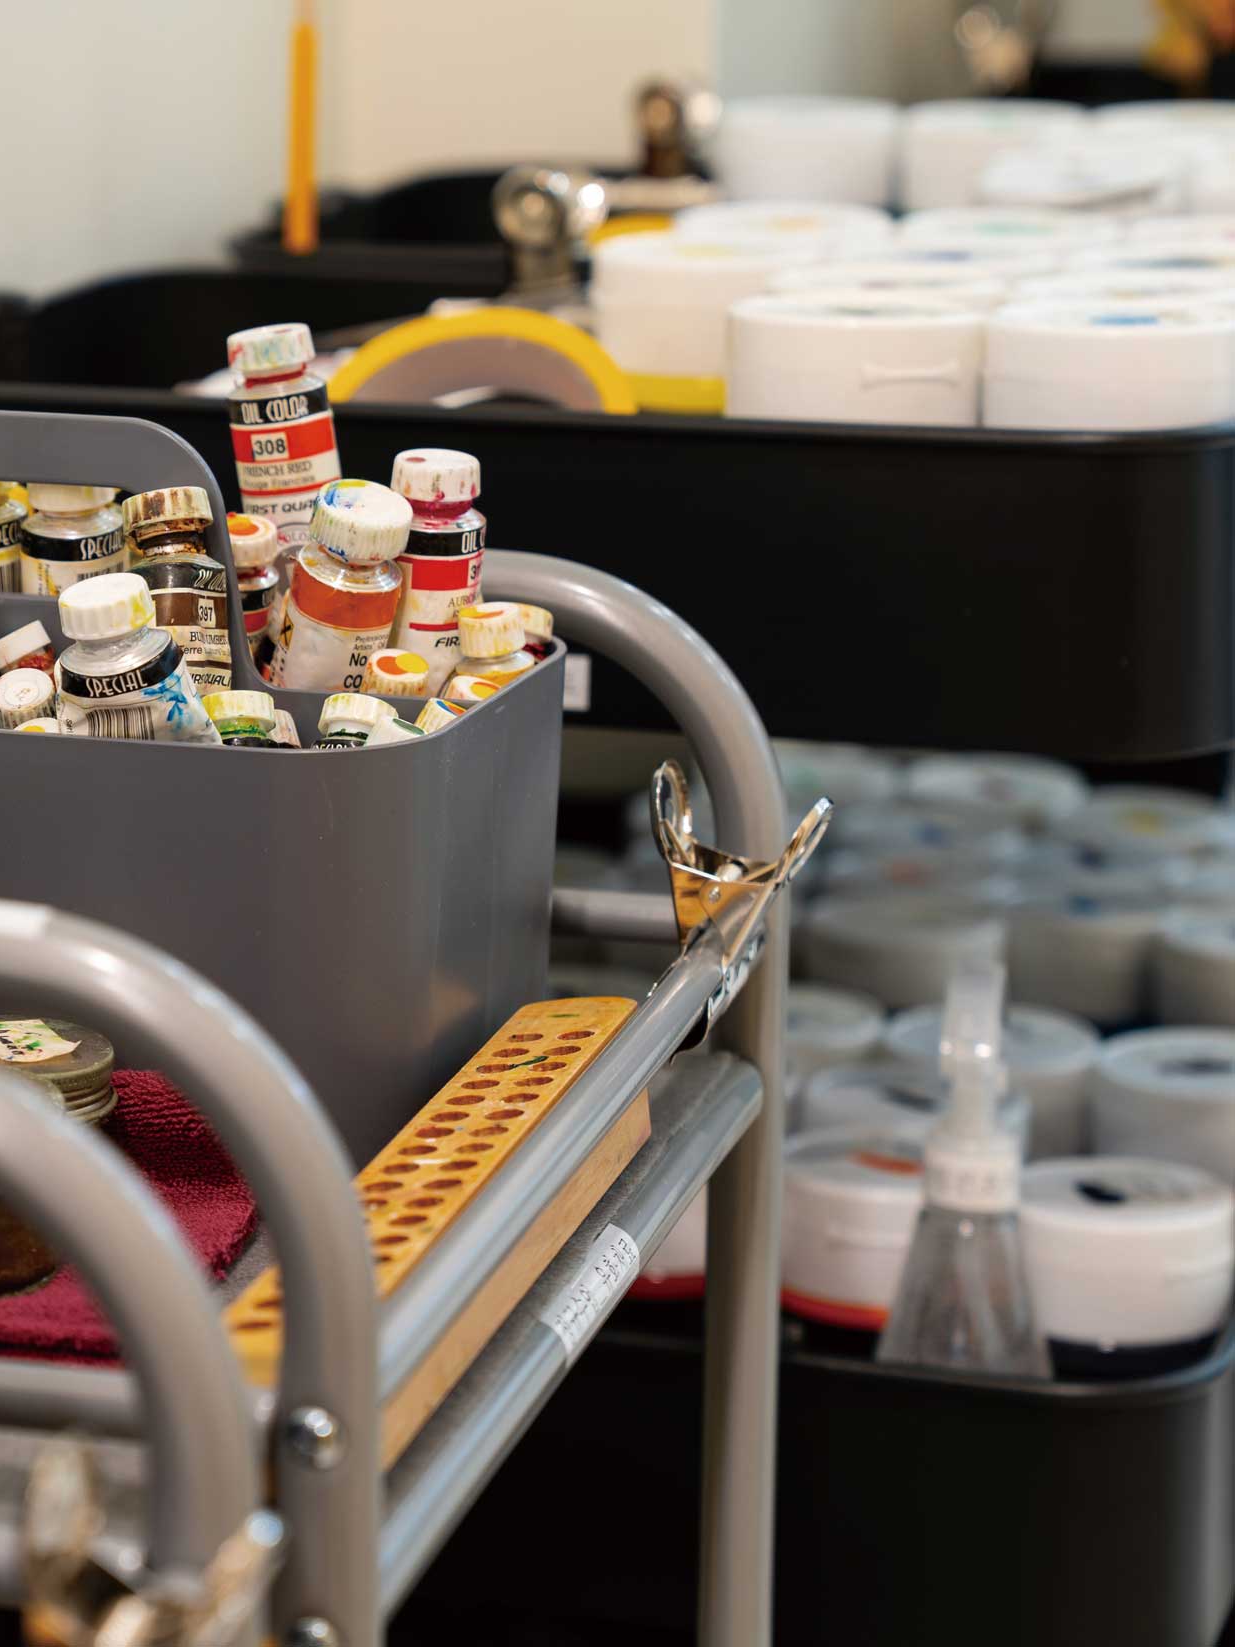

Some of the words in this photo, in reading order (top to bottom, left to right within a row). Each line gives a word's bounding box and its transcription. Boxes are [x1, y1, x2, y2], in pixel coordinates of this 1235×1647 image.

[241, 402, 264, 424] OIL
[265, 395, 309, 422] COLOR
[254, 438, 286, 455] 308
[461, 531, 477, 554] OIL
[199, 605, 213, 622] 397
[434, 636, 460, 648] FIR
[86, 669, 148, 698] SPECIAL
